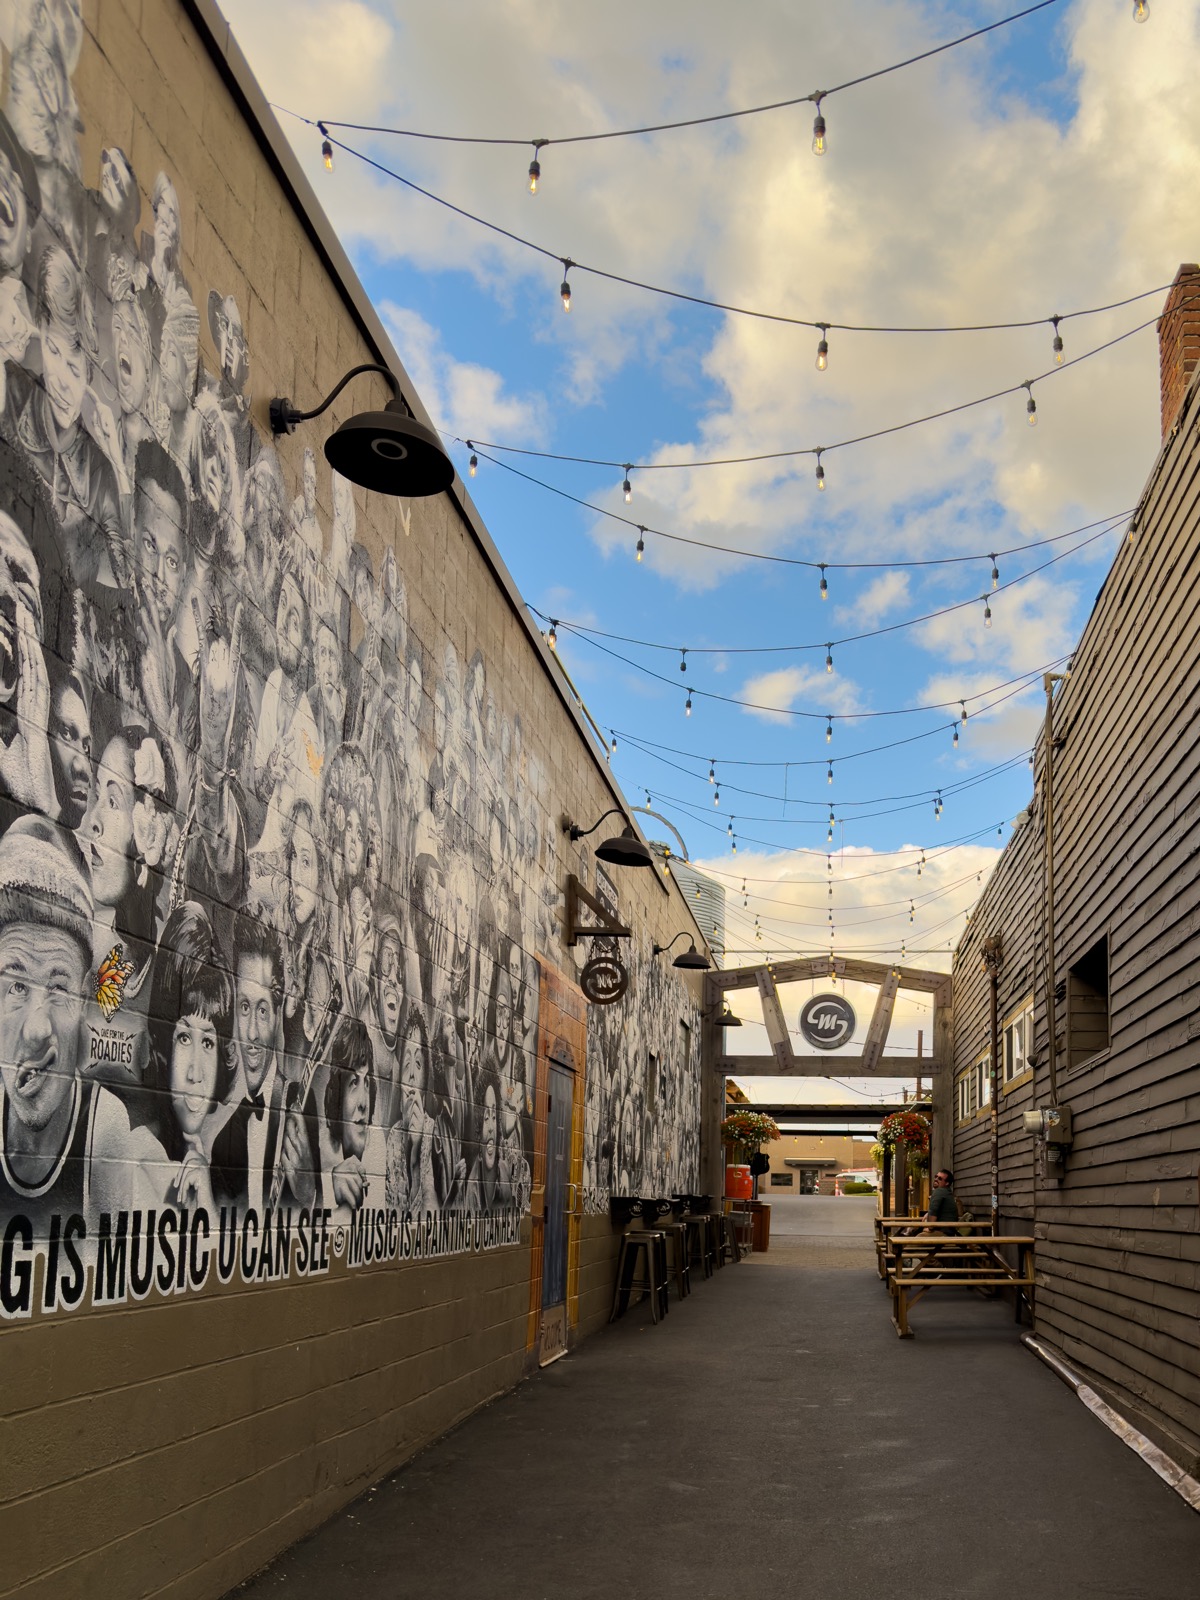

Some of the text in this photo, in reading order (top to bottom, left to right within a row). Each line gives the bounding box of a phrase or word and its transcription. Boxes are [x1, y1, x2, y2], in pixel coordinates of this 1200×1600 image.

[110, 1029, 118, 1039] FOR
[90, 1037, 133, 1064] ROADIES
[0, 1214, 33, 1313] G
[44, 1213, 87, 1307] IS
[94, 1207, 210, 1300] MUSIC
[218, 1206, 237, 1280] U
[241, 1207, 292, 1279] CAN
[296, 1207, 332, 1273] SEE
[348, 1207, 399, 1265] MUSIC
[400, 1209, 413, 1258] IS
[414, 1210, 422, 1257] A
[425, 1209, 472, 1257] PAINTING
[474, 1210, 481, 1251] U
[483, 1208, 500, 1249] CAN
